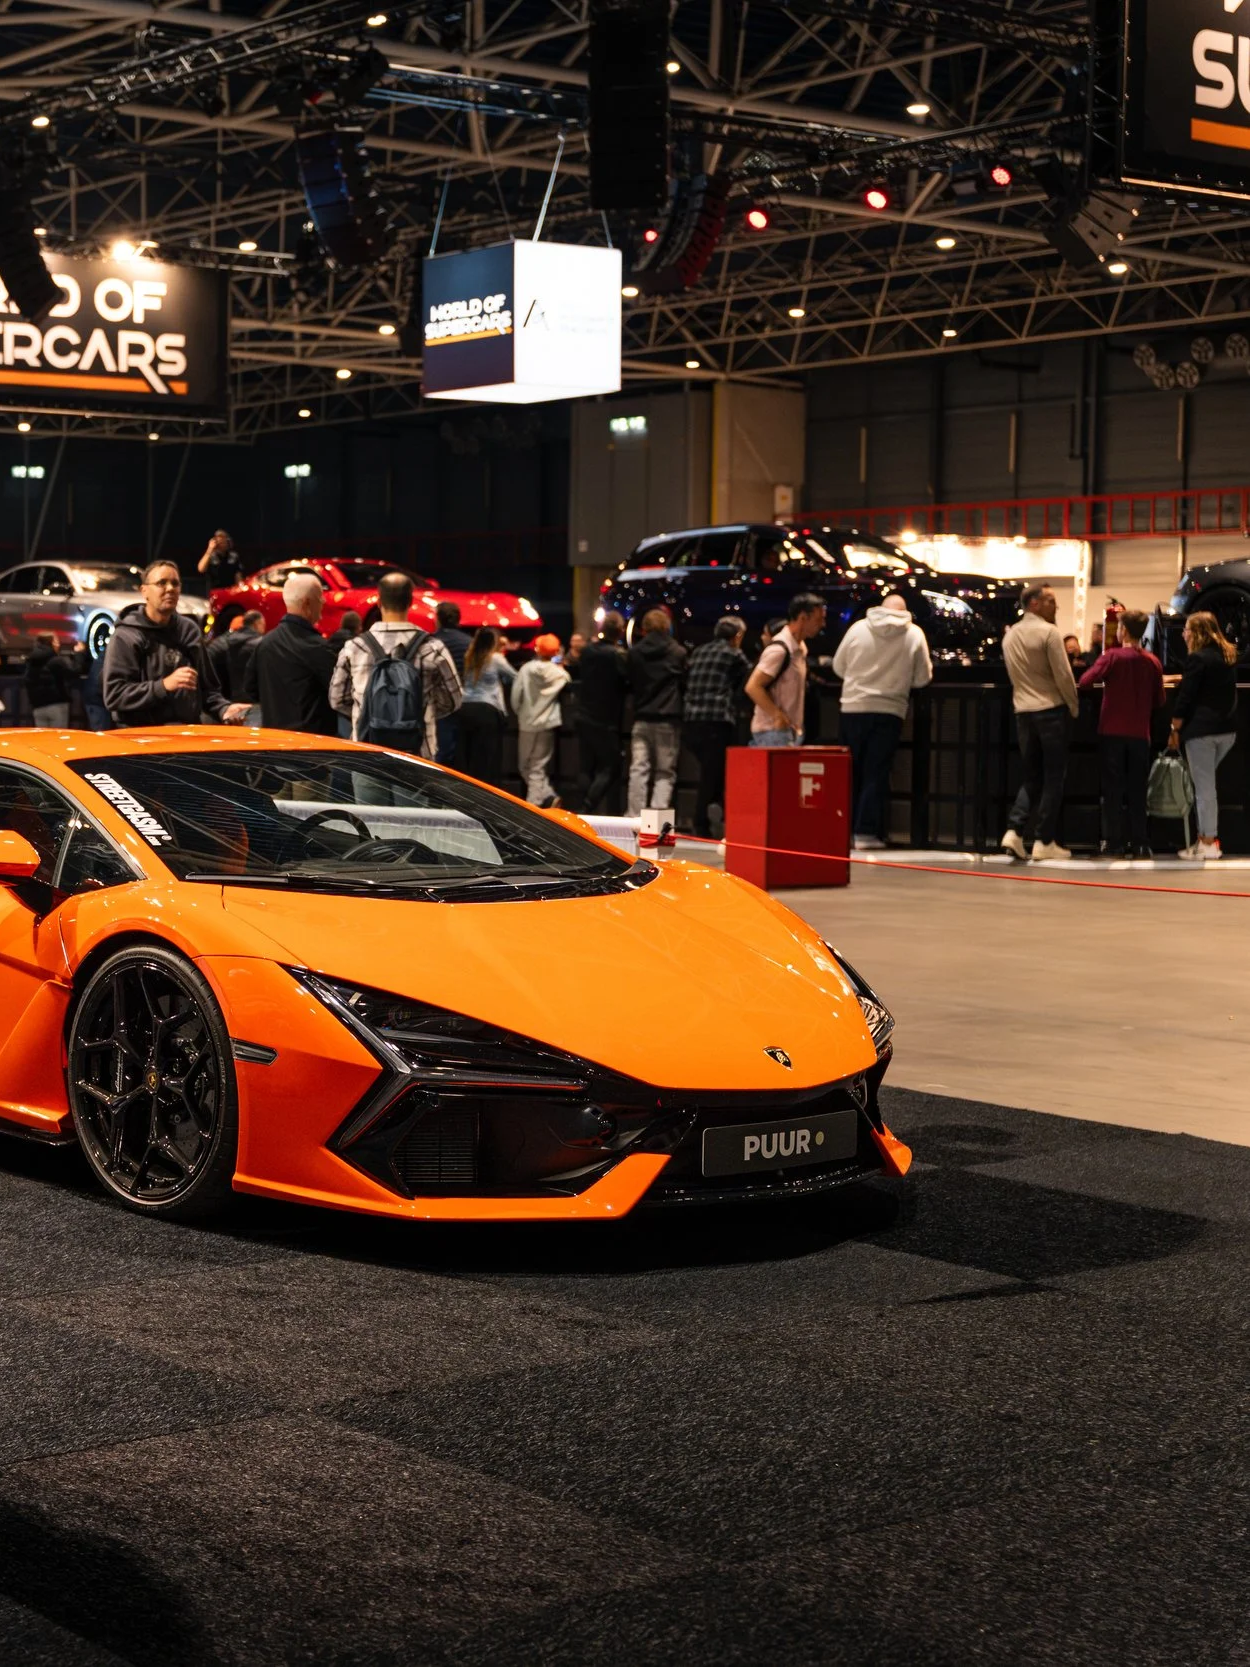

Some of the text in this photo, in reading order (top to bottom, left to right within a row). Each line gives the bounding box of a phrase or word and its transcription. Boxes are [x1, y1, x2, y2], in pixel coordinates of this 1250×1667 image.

[1192, 28, 1250, 114] S
[94, 277, 167, 323] OF
[483, 293, 507, 314] OF
[743, 1128, 811, 1161] PUUR
